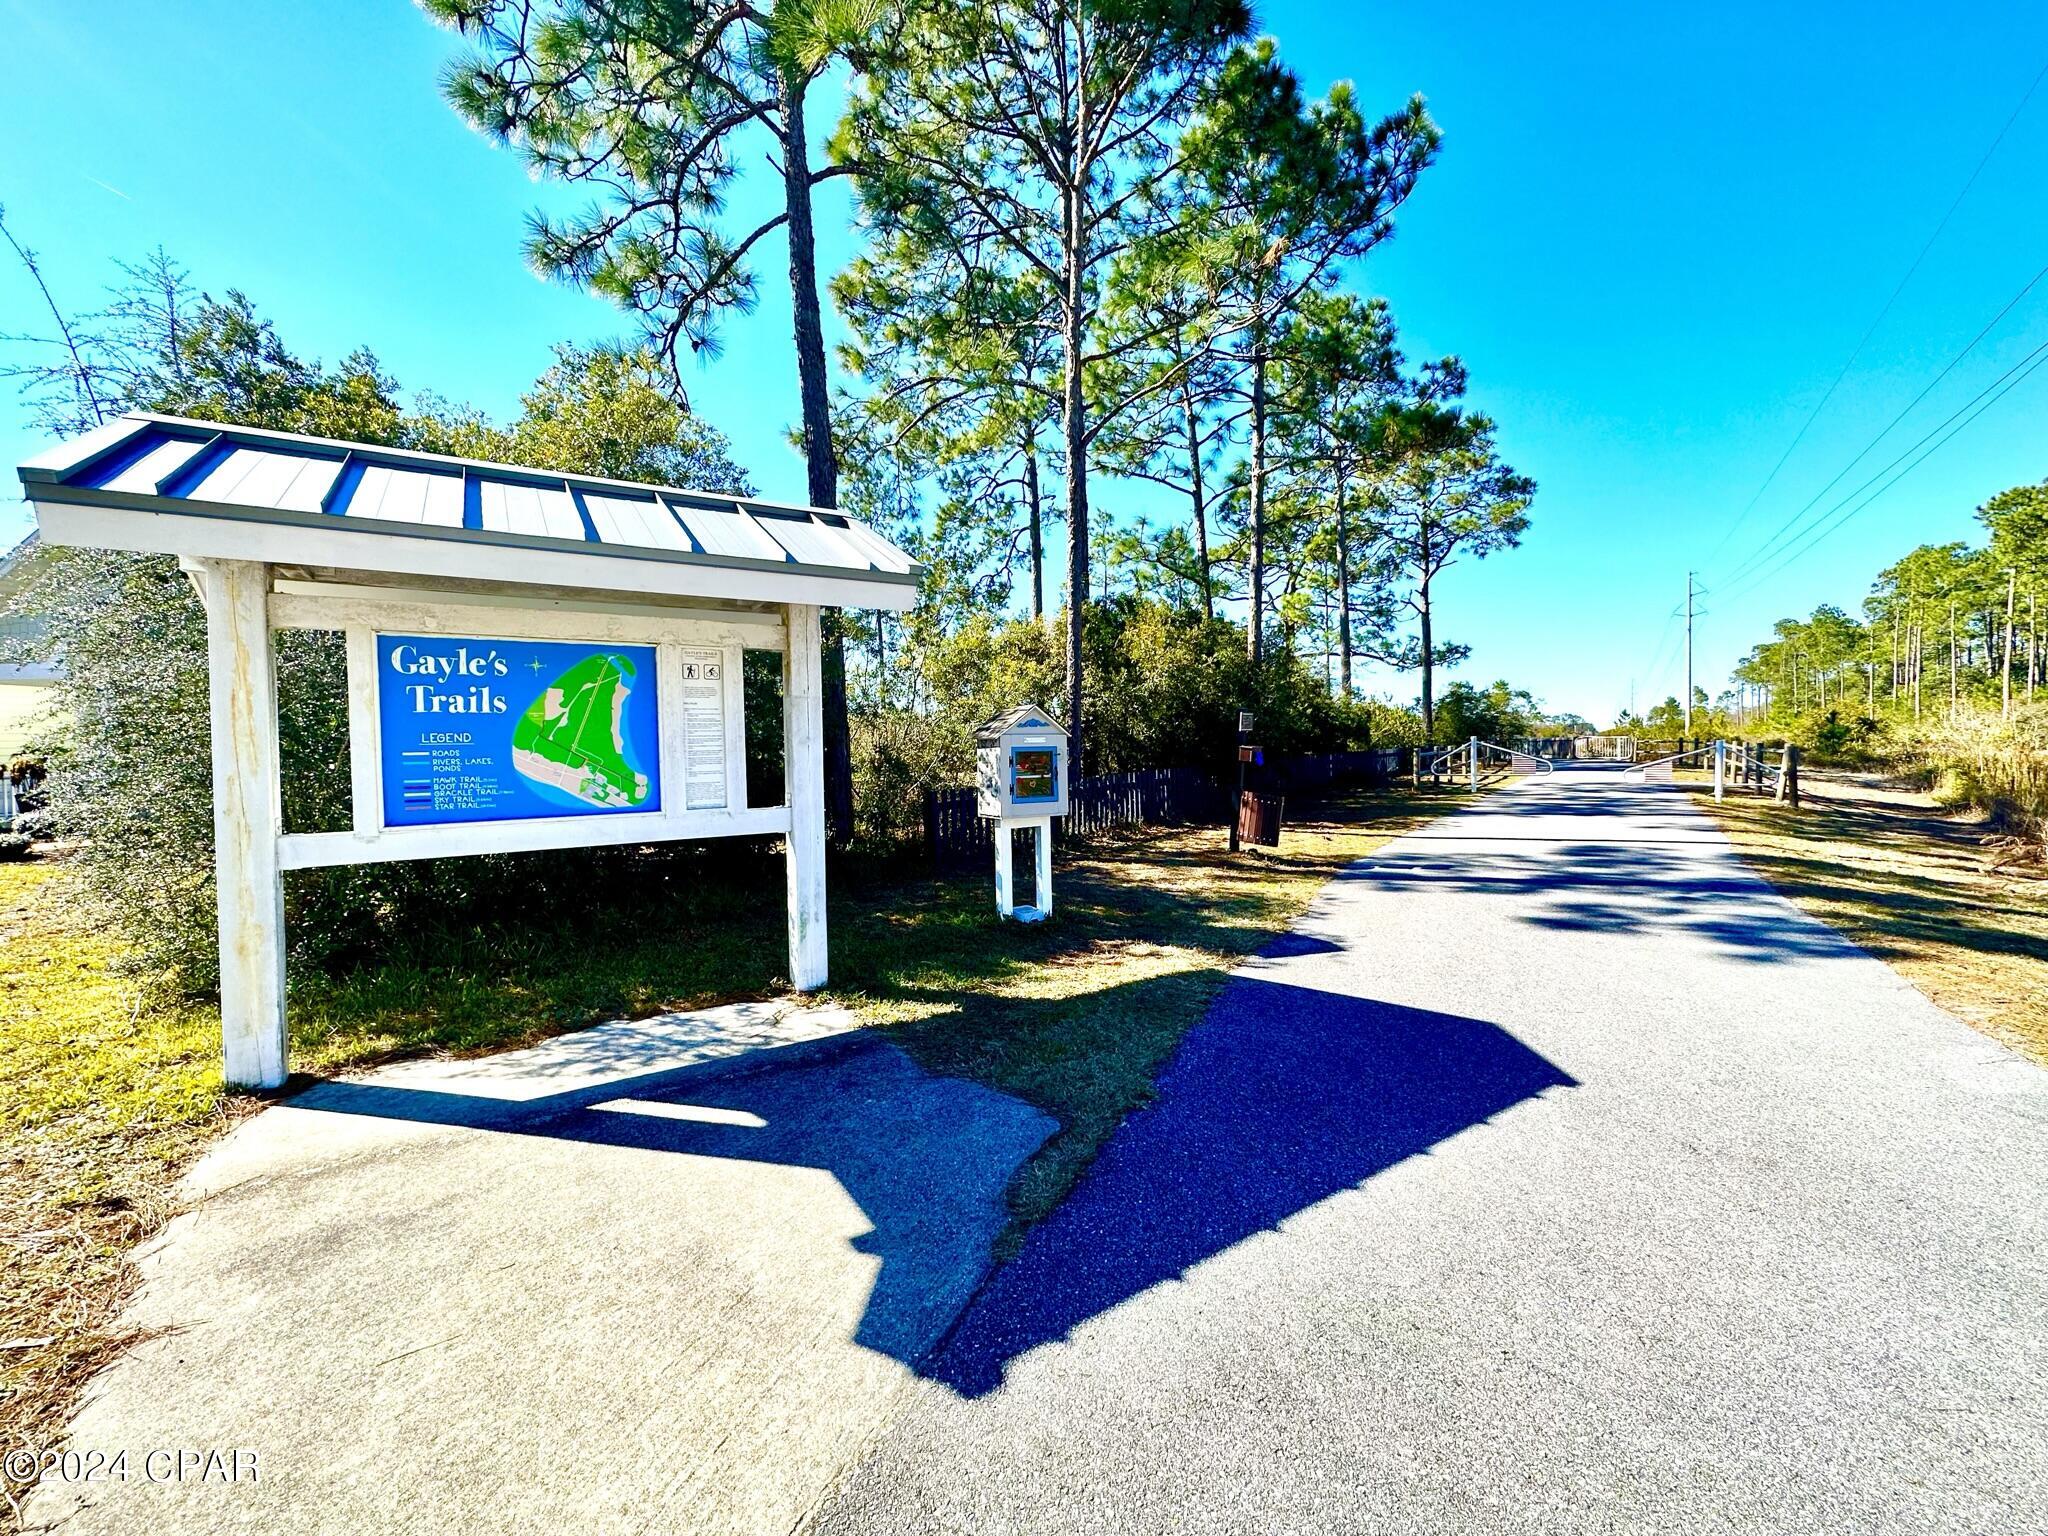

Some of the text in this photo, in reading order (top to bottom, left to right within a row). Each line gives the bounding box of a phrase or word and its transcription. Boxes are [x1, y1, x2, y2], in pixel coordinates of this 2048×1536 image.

[391, 645, 508, 683] Gayle's
[406, 685, 507, 713] Trails
[421, 733, 472, 743] LEGEND
